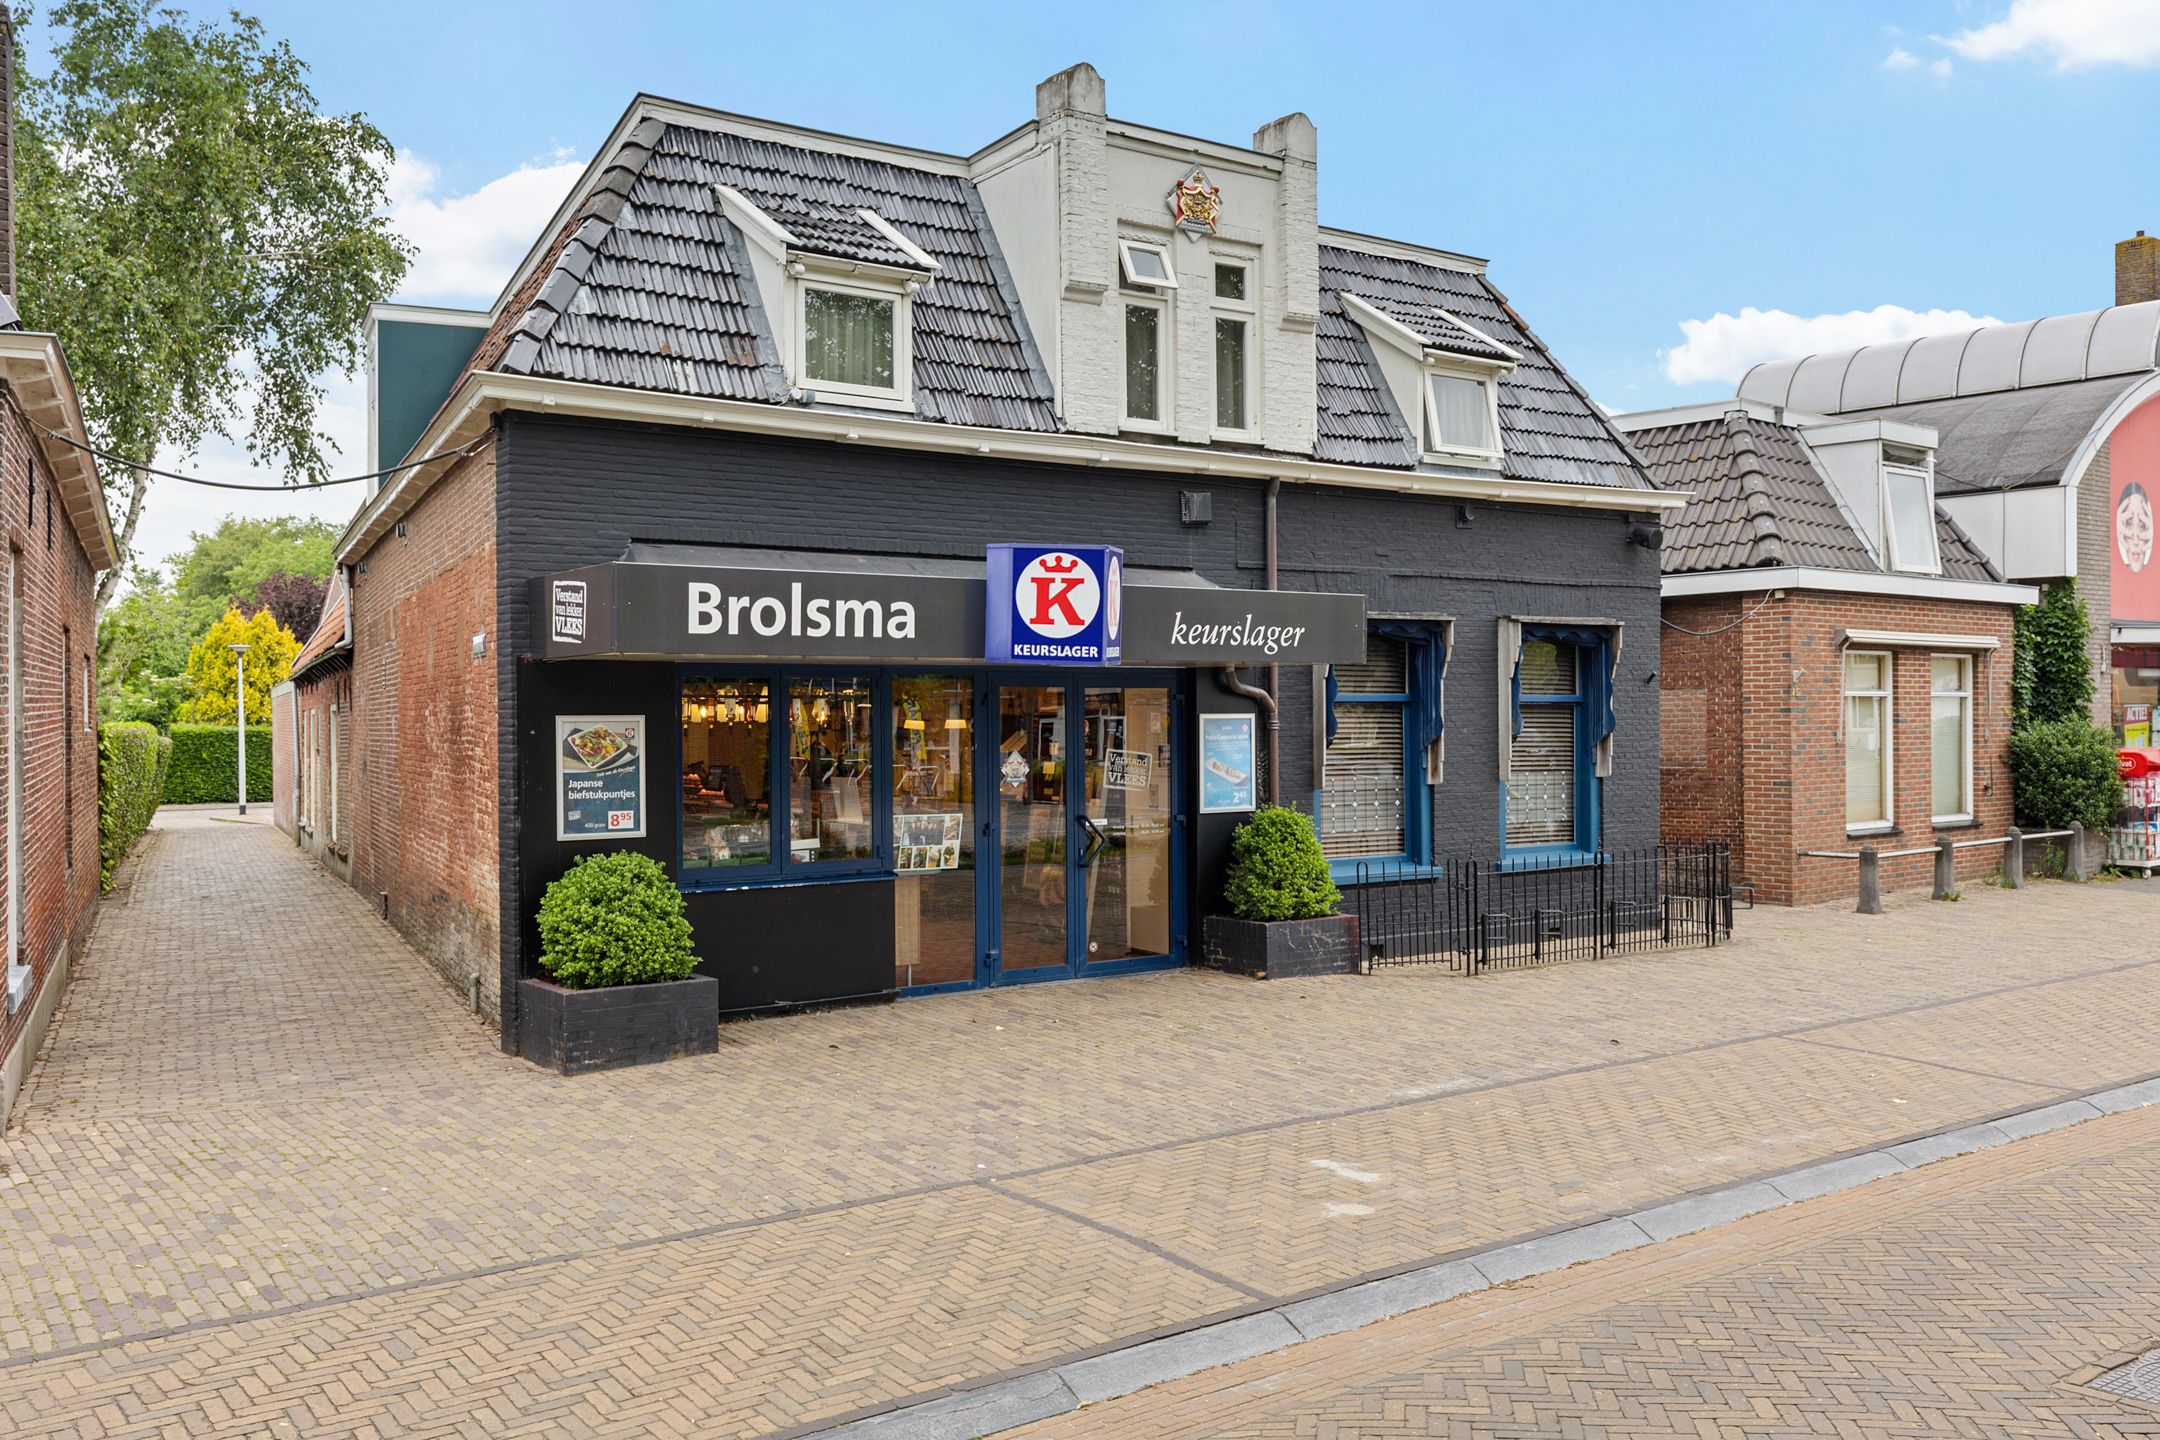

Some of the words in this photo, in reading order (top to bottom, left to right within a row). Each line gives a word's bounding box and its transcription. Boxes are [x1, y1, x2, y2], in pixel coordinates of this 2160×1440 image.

[555, 588, 583, 603] Verstand
[1029, 577, 1085, 626] K
[555, 605, 565, 615] van
[566, 603, 583, 617] lekker
[687, 582, 916, 639] Brolsma
[555, 617, 583, 635] VLEES
[1171, 611, 1305, 655] keurslager
[1013, 644, 1098, 658] KEURSLAGER
[2126, 706, 2148, 721] ACTIE!
[1109, 753, 1147, 767] Verstand
[1108, 764, 1122, 772] van
[568, 780, 603, 791] Japanse
[1108, 772, 1146, 786] VLEES
[568, 789, 636, 802] biefstukpuntjes
